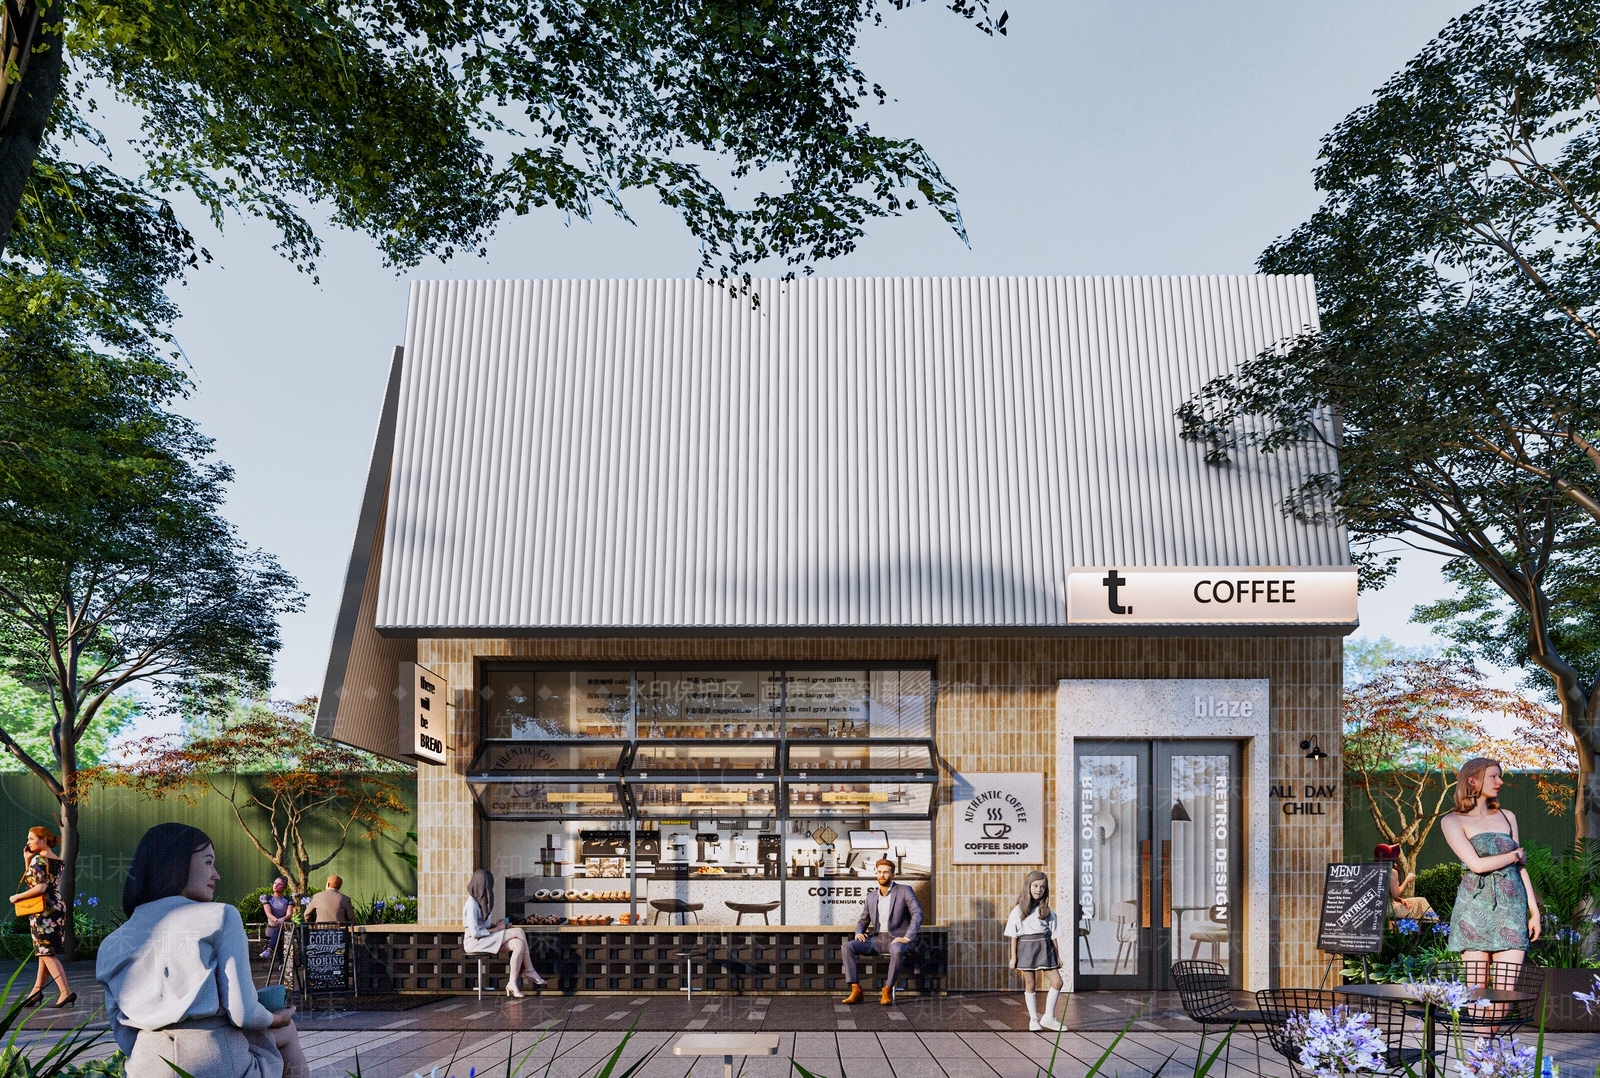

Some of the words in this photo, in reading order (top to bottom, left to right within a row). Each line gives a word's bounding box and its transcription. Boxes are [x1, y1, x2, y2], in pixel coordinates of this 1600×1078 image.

[1194, 580, 1296, 604] COFFEE
[1194, 696, 1254, 718] blaze
[420, 714, 428, 729] be
[420, 732, 442, 754] BREAD
[1269, 785, 1296, 798] ALL
[1304, 785, 1336, 798] DAY
[964, 790, 1002, 824] AUTHENTIC
[1004, 794, 1027, 823] COFFEE
[1216, 776, 1227, 840] RETRO
[1282, 802, 1326, 816] CHILL
[1330, 865, 1360, 877] MENU
[808, 887, 861, 897] COFFEE
[1216, 848, 1227, 919] DESIGN
[1340, 891, 1374, 924] ENTREES
[1372, 909, 1382, 930] Kevin
[309, 934, 343, 945] COFFEE
[308, 957, 345, 965] MORING
